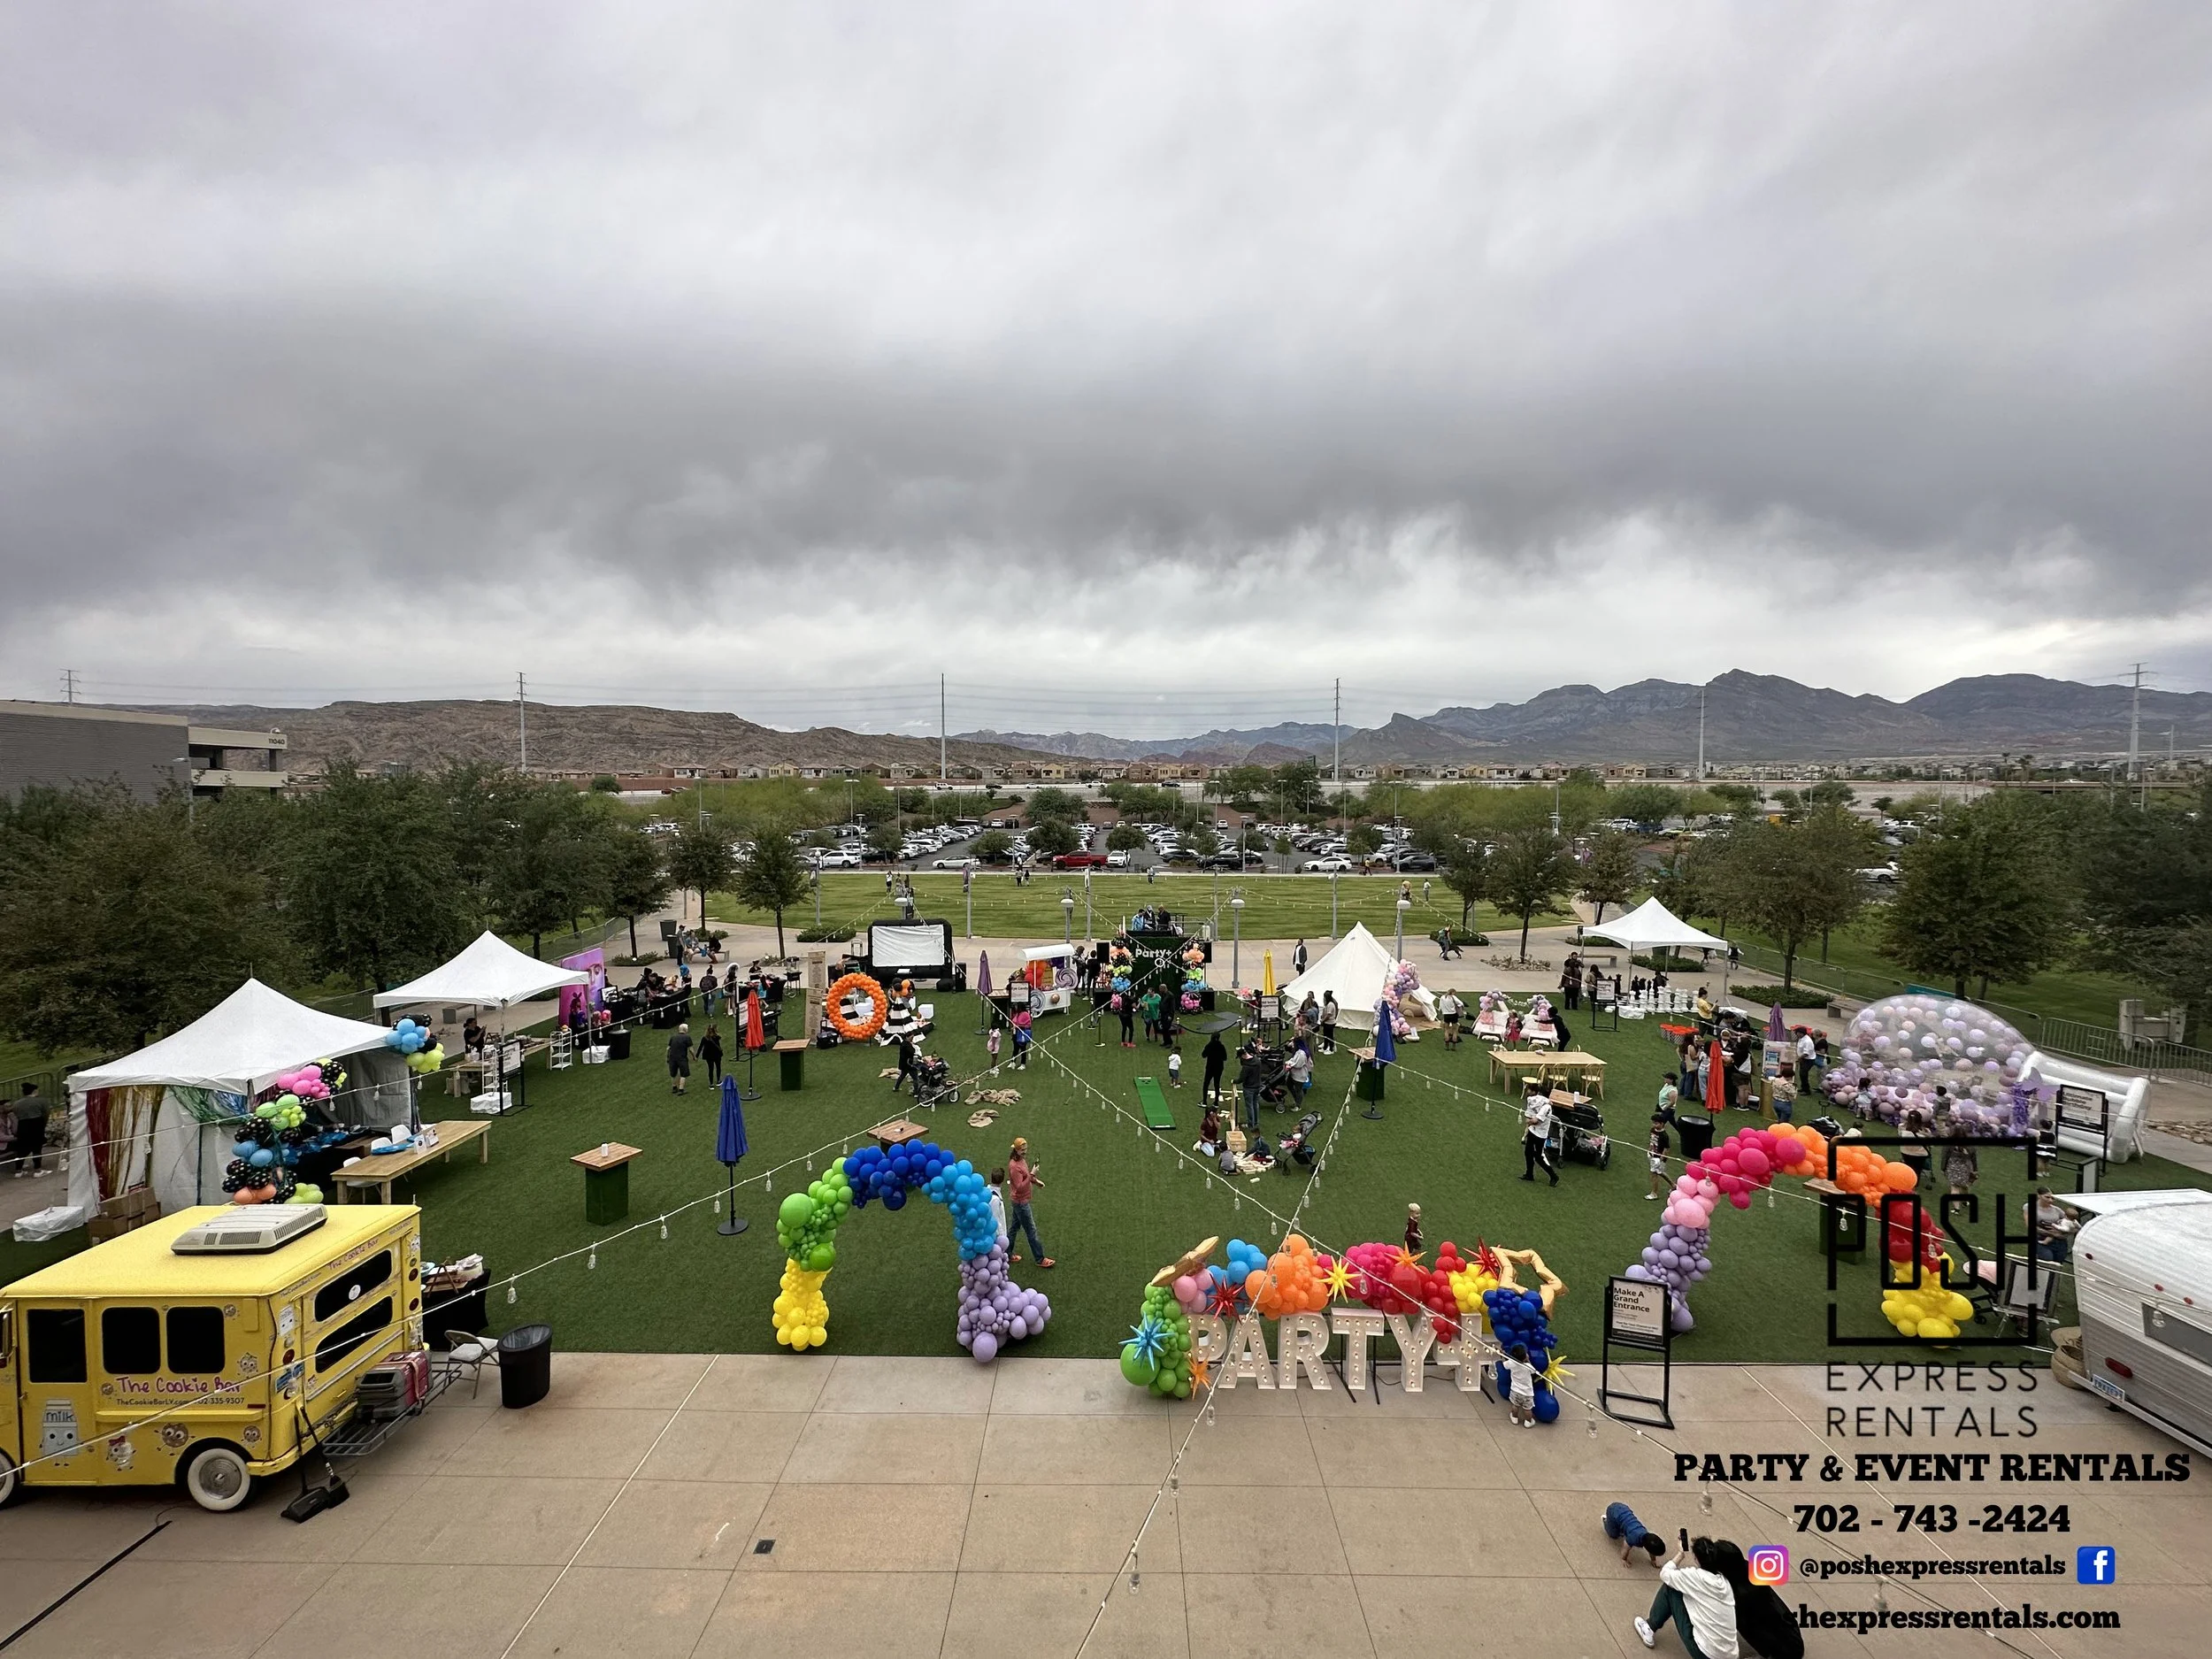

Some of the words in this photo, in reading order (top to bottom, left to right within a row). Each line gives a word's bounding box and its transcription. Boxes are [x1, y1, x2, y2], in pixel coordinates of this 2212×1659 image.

[1614, 1287, 1637, 1296] Make
[1613, 1294, 1639, 1303] Grand
[1613, 1302, 1650, 1312] Entrance
[116, 1376, 150, 1394] The
[156, 1377, 209, 1394] Cookie
[214, 1376, 242, 1394] Bar
[46, 1410, 74, 1423] milk
